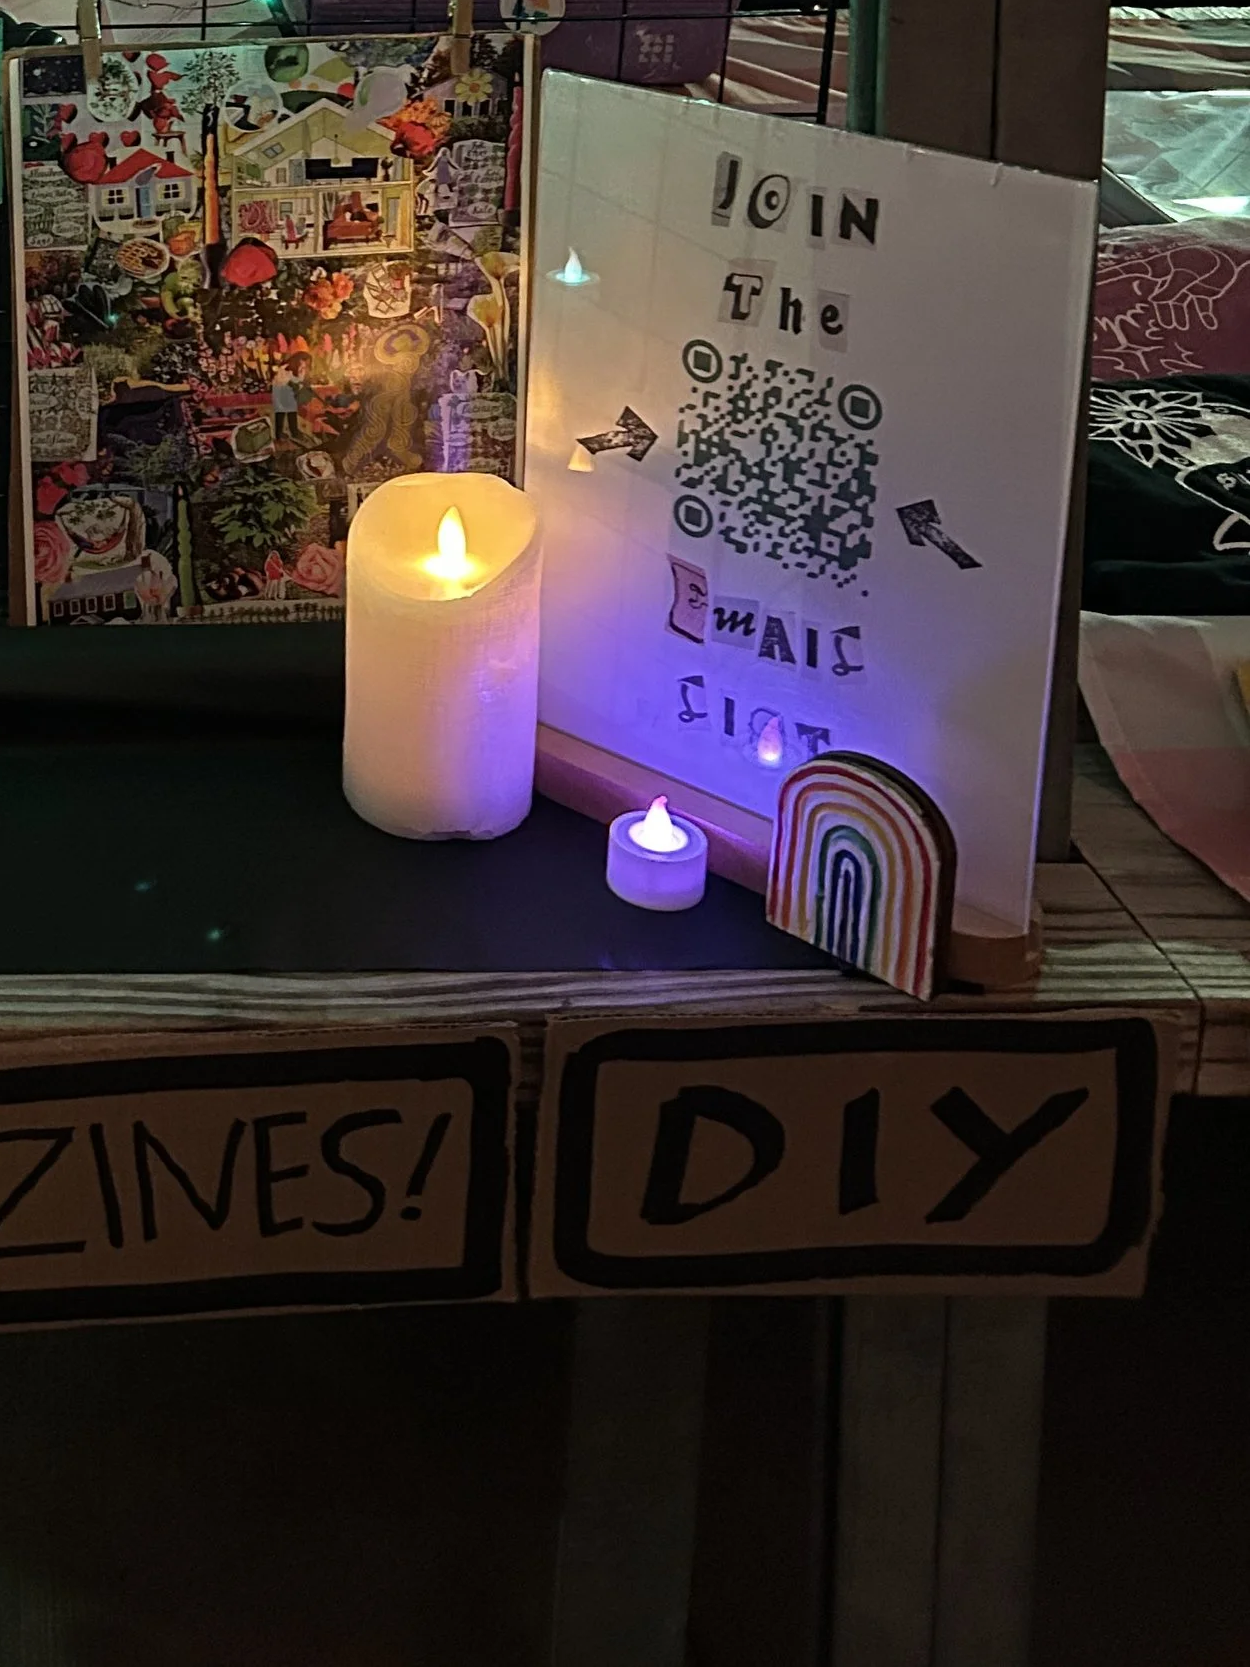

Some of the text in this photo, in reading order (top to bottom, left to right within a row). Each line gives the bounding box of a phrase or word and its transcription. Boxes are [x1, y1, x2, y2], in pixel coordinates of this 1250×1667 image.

[714, 160, 881, 245] JOIN
[723, 271, 846, 336] The
[640, 1085, 1090, 1226] DIY
